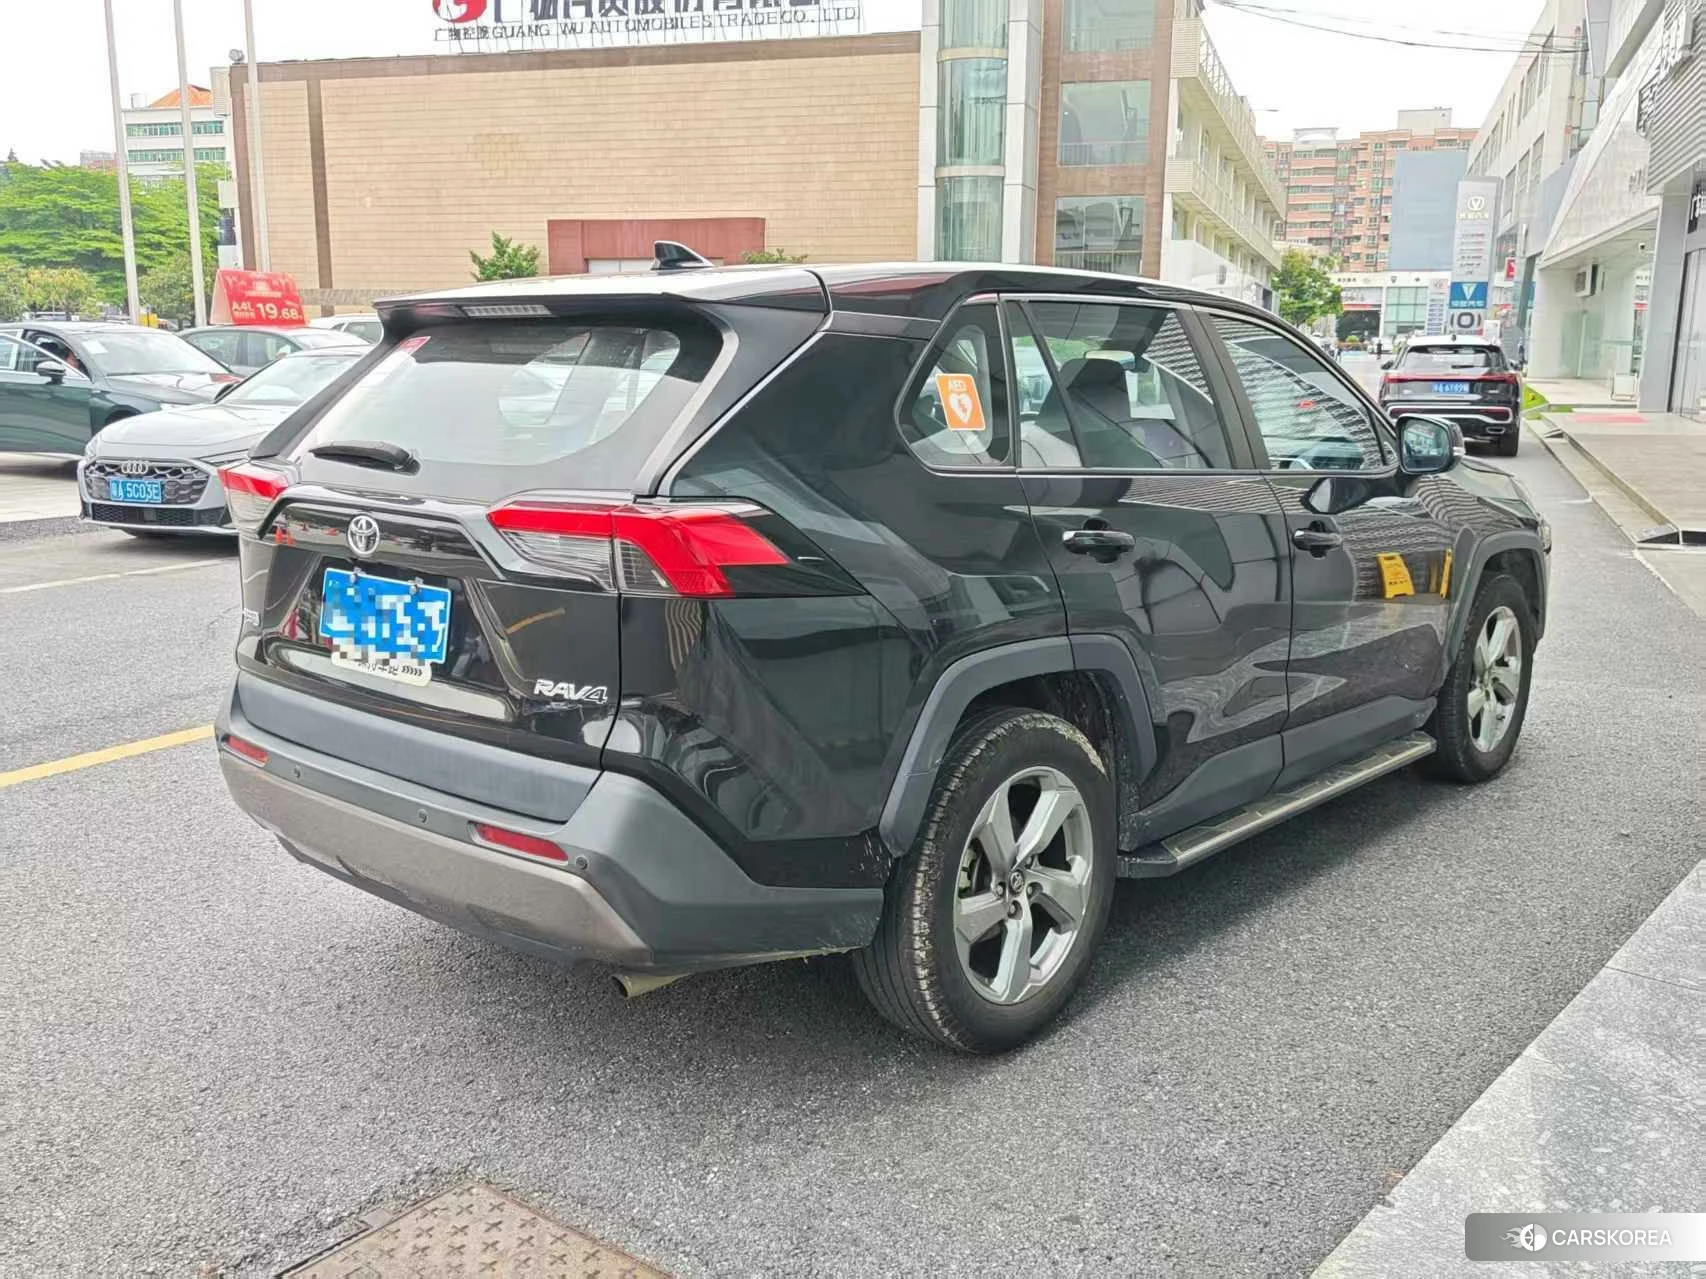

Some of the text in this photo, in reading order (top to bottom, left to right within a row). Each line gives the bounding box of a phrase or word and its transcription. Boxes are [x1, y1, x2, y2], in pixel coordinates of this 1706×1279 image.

[492, 23, 550, 38] GUANG
[560, 21, 584, 35] WU
[590, 15, 713, 34] AUTOMOBILES
[718, 11, 777, 27] TRADE
[533, 679, 608, 704] RAV4
